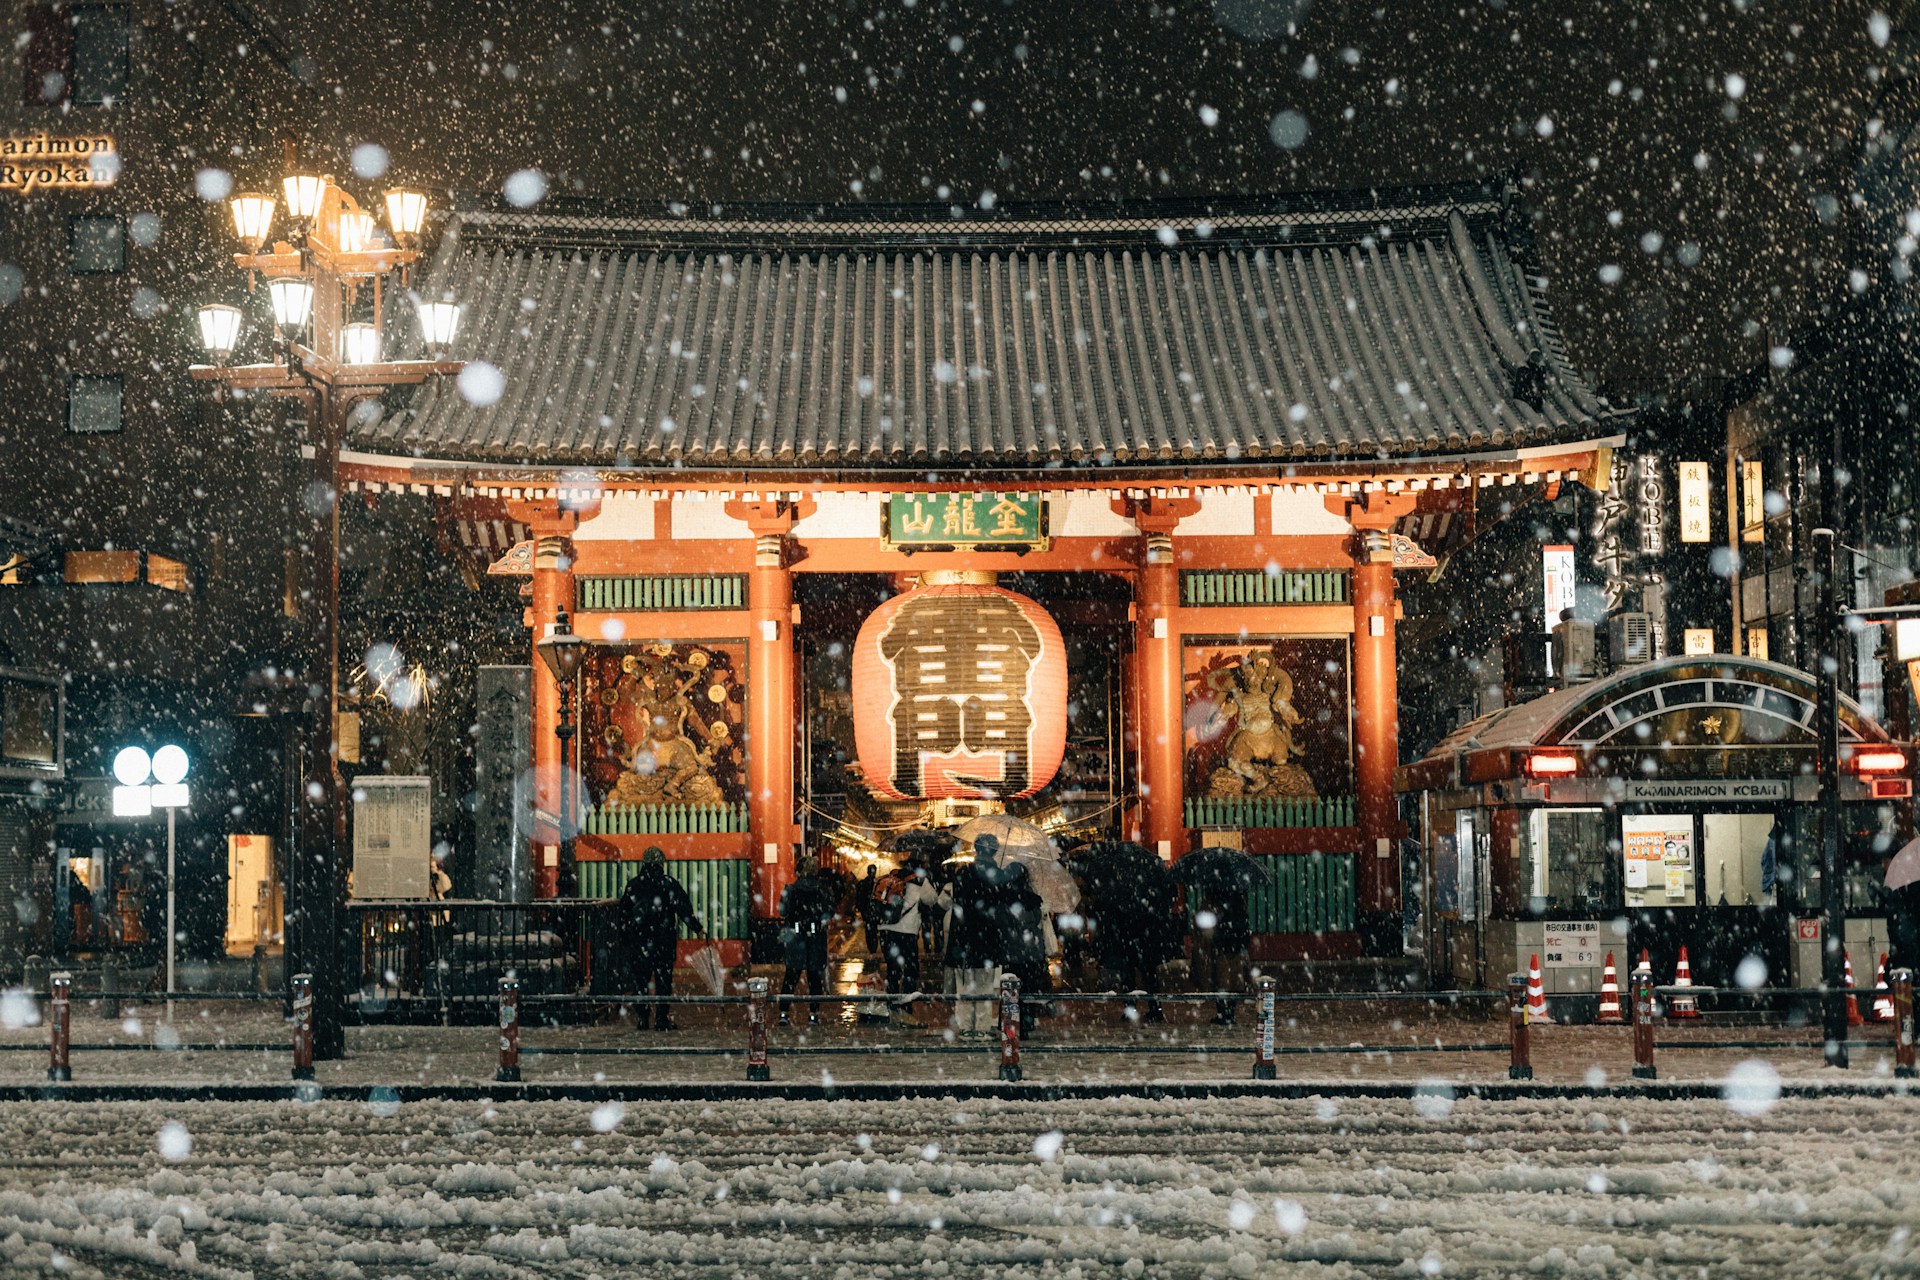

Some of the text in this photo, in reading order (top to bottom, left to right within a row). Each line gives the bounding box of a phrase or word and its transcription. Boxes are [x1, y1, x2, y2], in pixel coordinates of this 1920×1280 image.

[0, 163, 108, 189] Ryokan
[1644, 456, 1663, 551] KOBE
[1635, 785, 1778, 797] KAMINARIMON KOBAN
[1546, 937, 1562, 947] 死亡
[1547, 953, 1562, 962] 負傷
